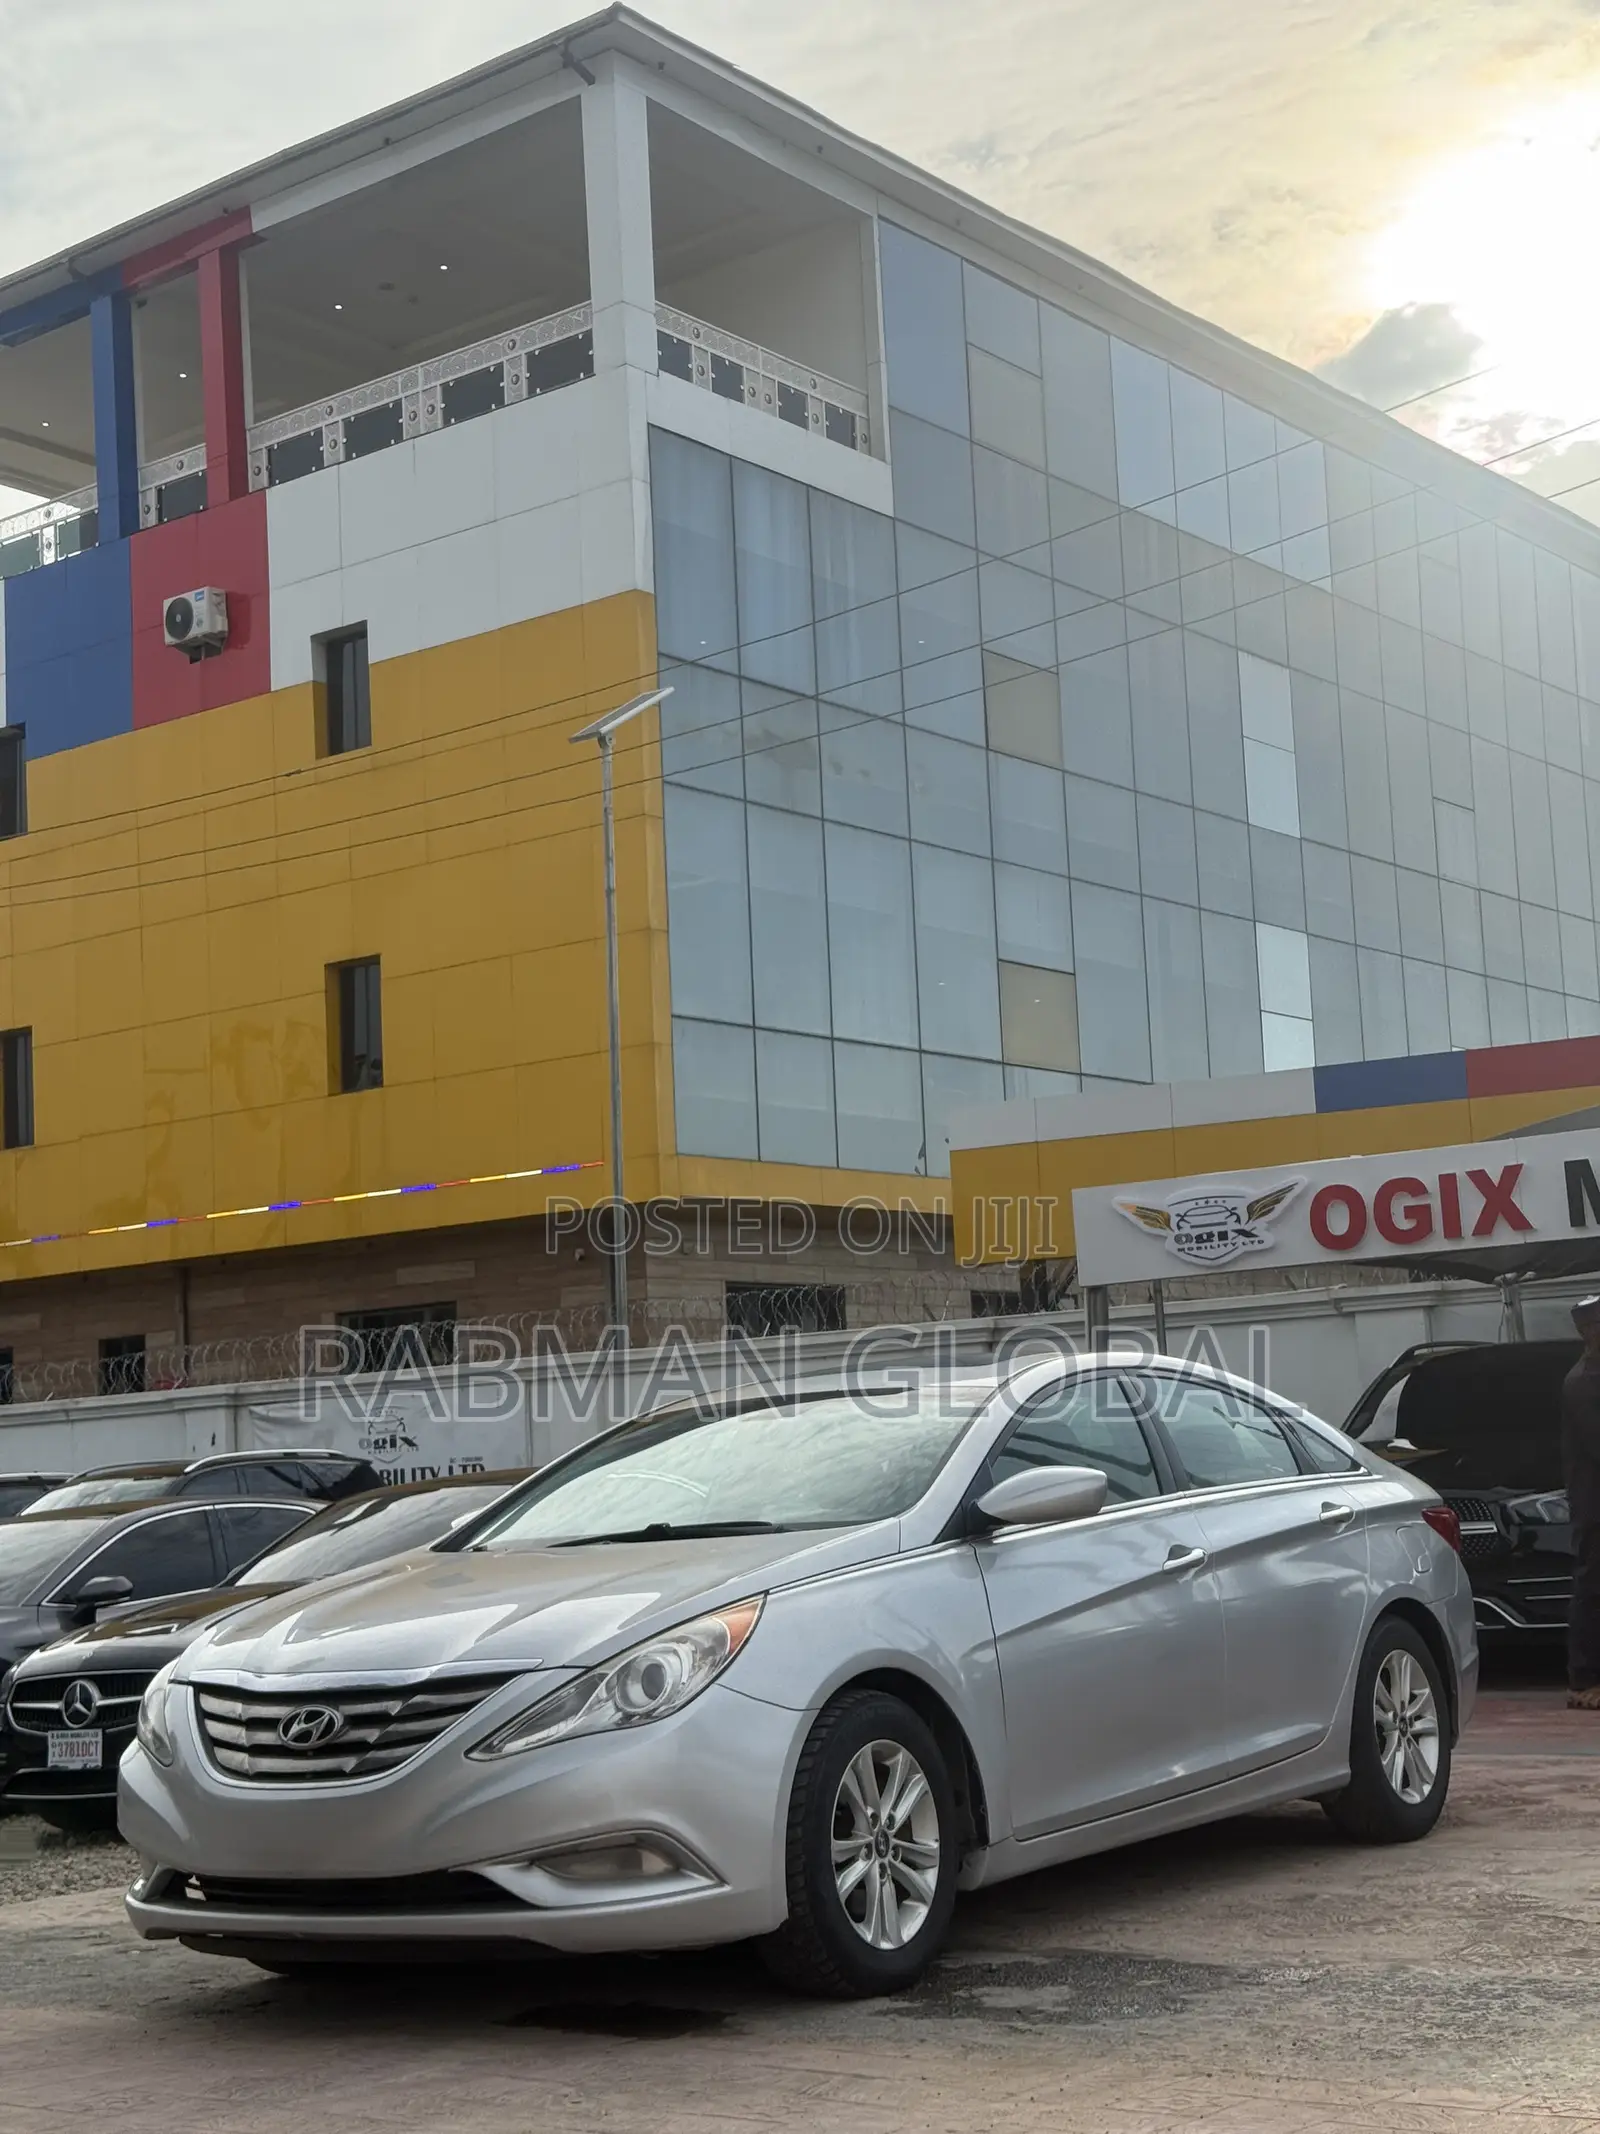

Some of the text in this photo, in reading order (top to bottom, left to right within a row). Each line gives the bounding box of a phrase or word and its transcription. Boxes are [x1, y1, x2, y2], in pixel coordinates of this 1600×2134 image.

[1310, 1163, 1535, 1251] OGIX
[1177, 1239, 1265, 1252] MOBILITY LTD
